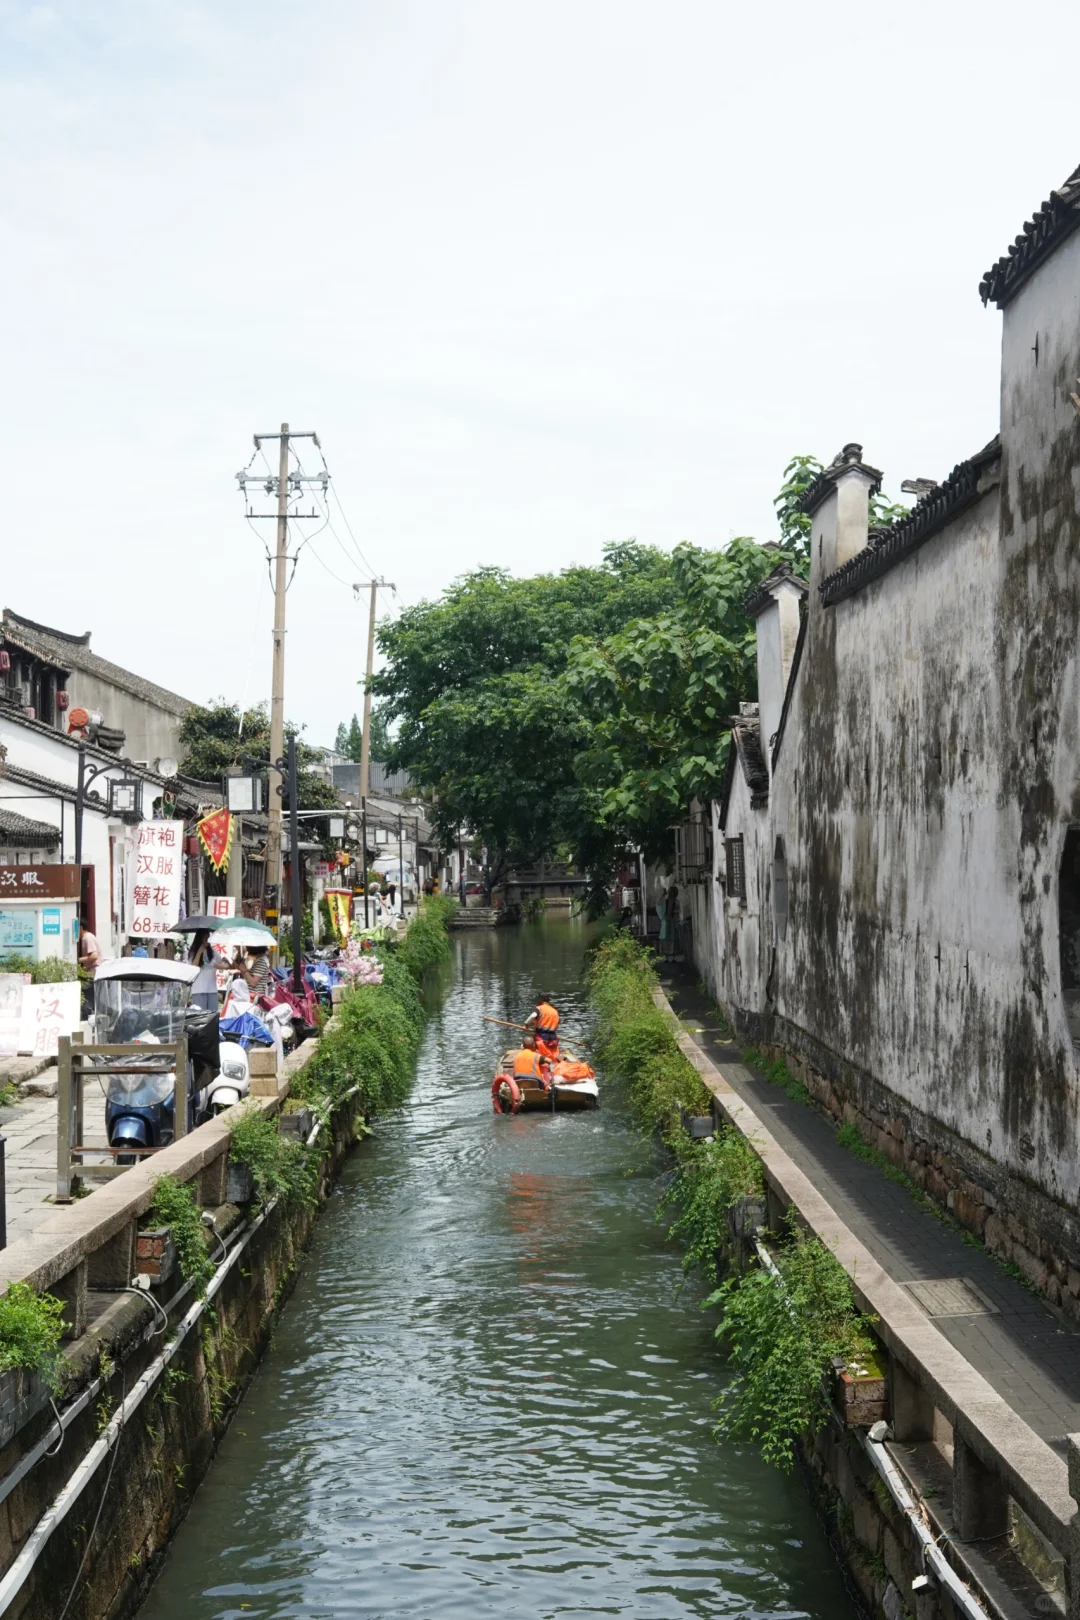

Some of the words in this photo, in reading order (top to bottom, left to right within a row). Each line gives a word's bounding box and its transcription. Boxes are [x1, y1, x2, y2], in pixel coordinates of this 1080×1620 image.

[138, 827, 175, 847] 旗袍
[137, 854, 173, 875] 汉服
[133, 885, 171, 906] 簪花
[133, 917, 171, 933] 68元起
